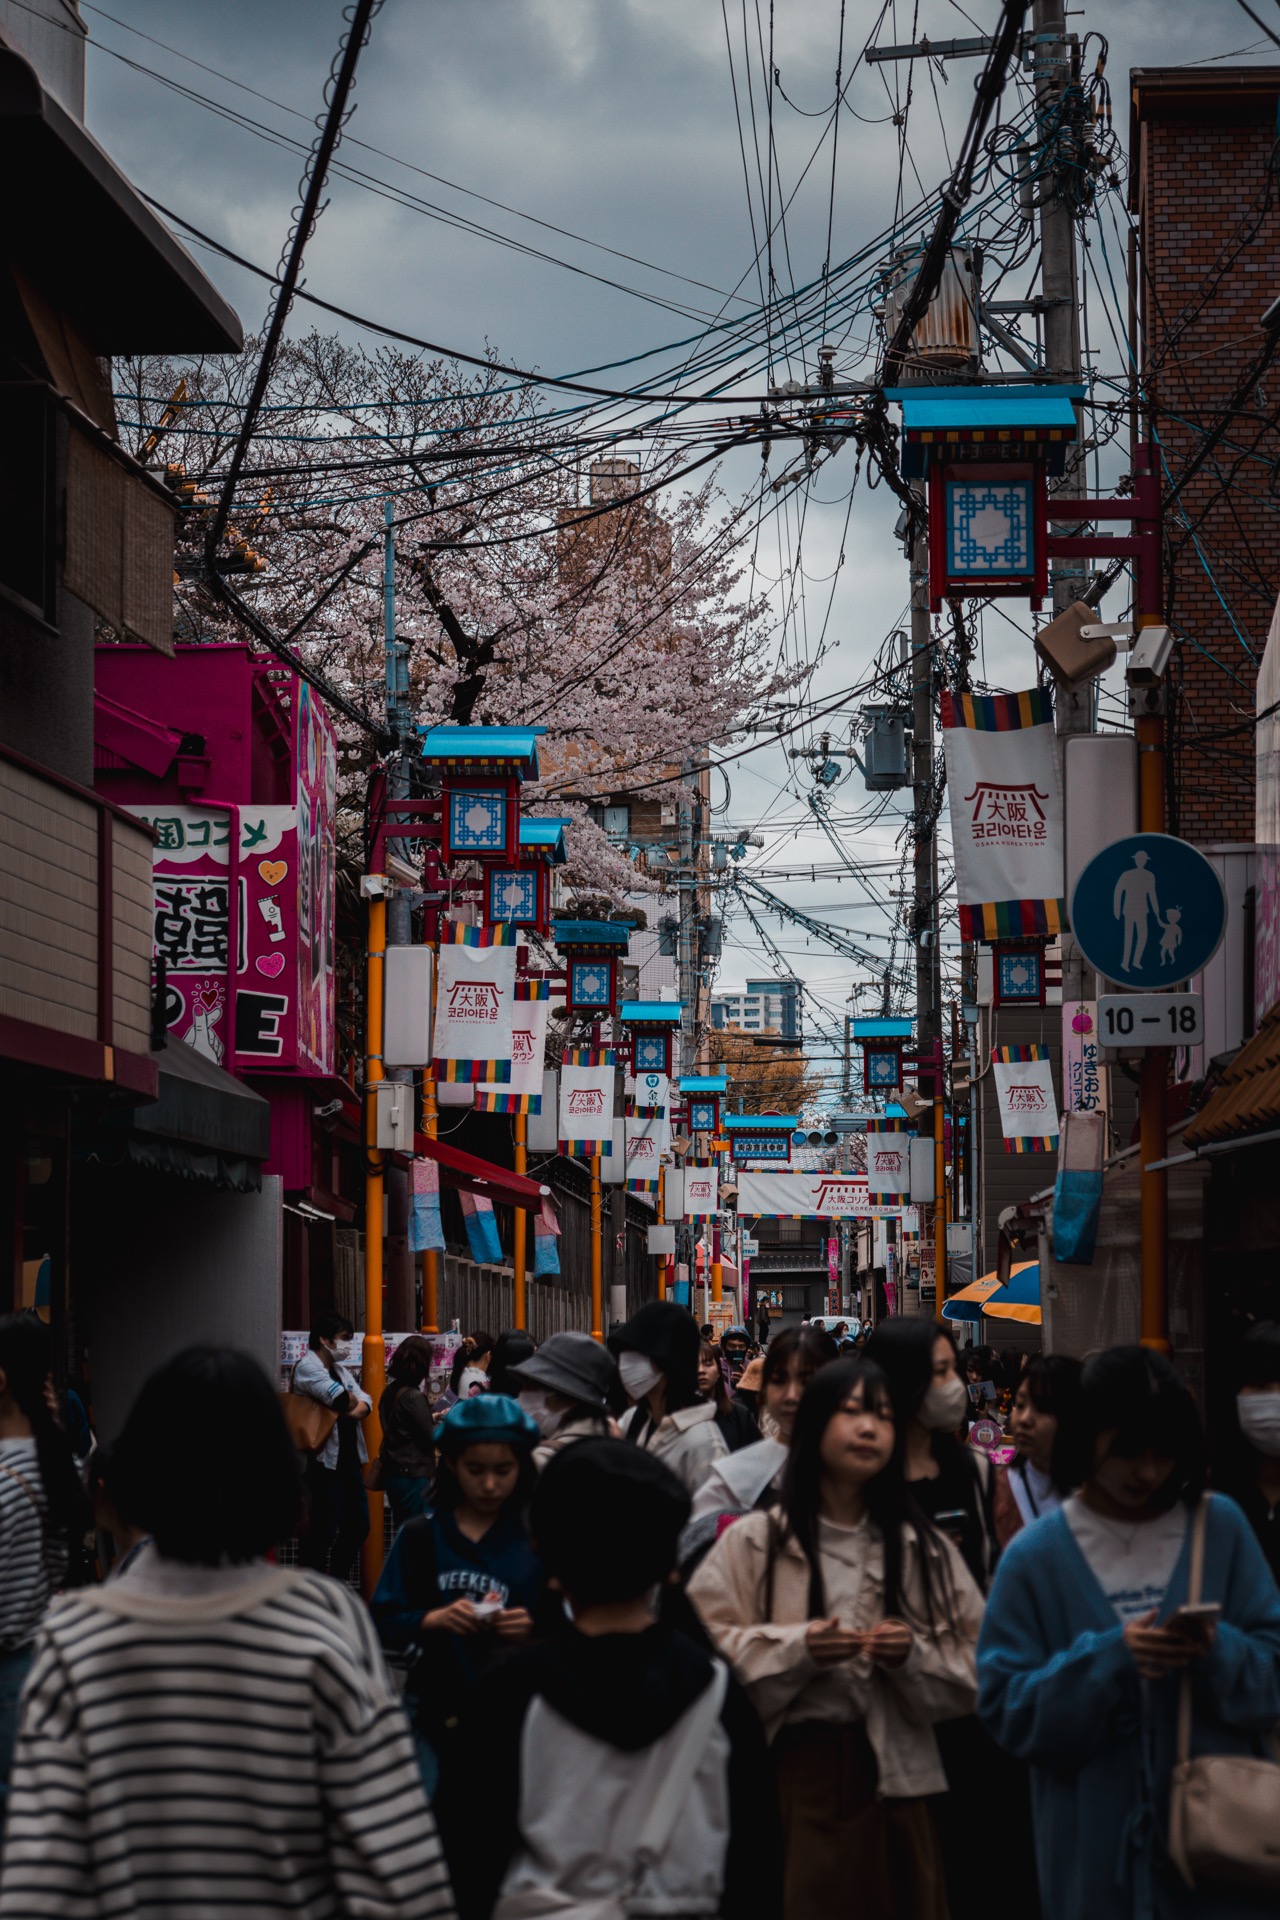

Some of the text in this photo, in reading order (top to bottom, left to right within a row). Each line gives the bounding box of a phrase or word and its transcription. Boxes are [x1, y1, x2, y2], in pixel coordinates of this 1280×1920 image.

[987, 800, 1028, 822] 大阪
[971, 821, 1047, 839] 코리아타운
[459, 993, 489, 1007] 大阪
[448, 1007, 498, 1020] 코리아타운
[1083, 1043, 1100, 1110] ゆきおか
[576, 1098, 596, 1106] 大阪
[1016, 1093, 1036, 1103] 大阪
[568, 1105, 603, 1114] 코리아타운
[828, 1195, 869, 1204] 大阪コリア
